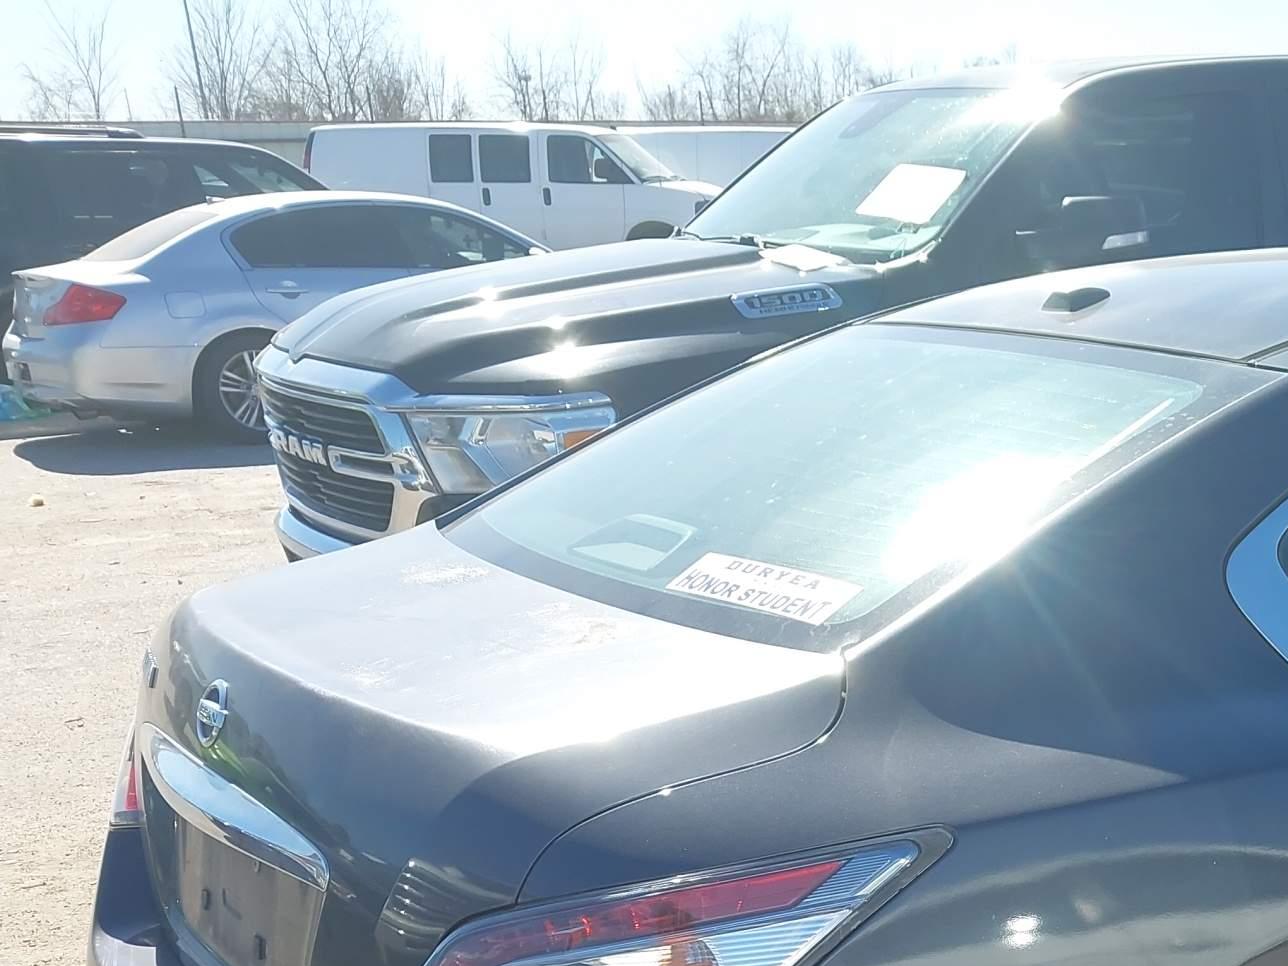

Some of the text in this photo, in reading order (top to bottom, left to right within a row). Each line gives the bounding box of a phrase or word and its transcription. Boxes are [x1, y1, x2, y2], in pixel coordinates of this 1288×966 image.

[268, 427, 328, 466] RAM
[675, 568, 833, 620] HONOR STUDENT
[724, 559, 821, 590] DURYEA
